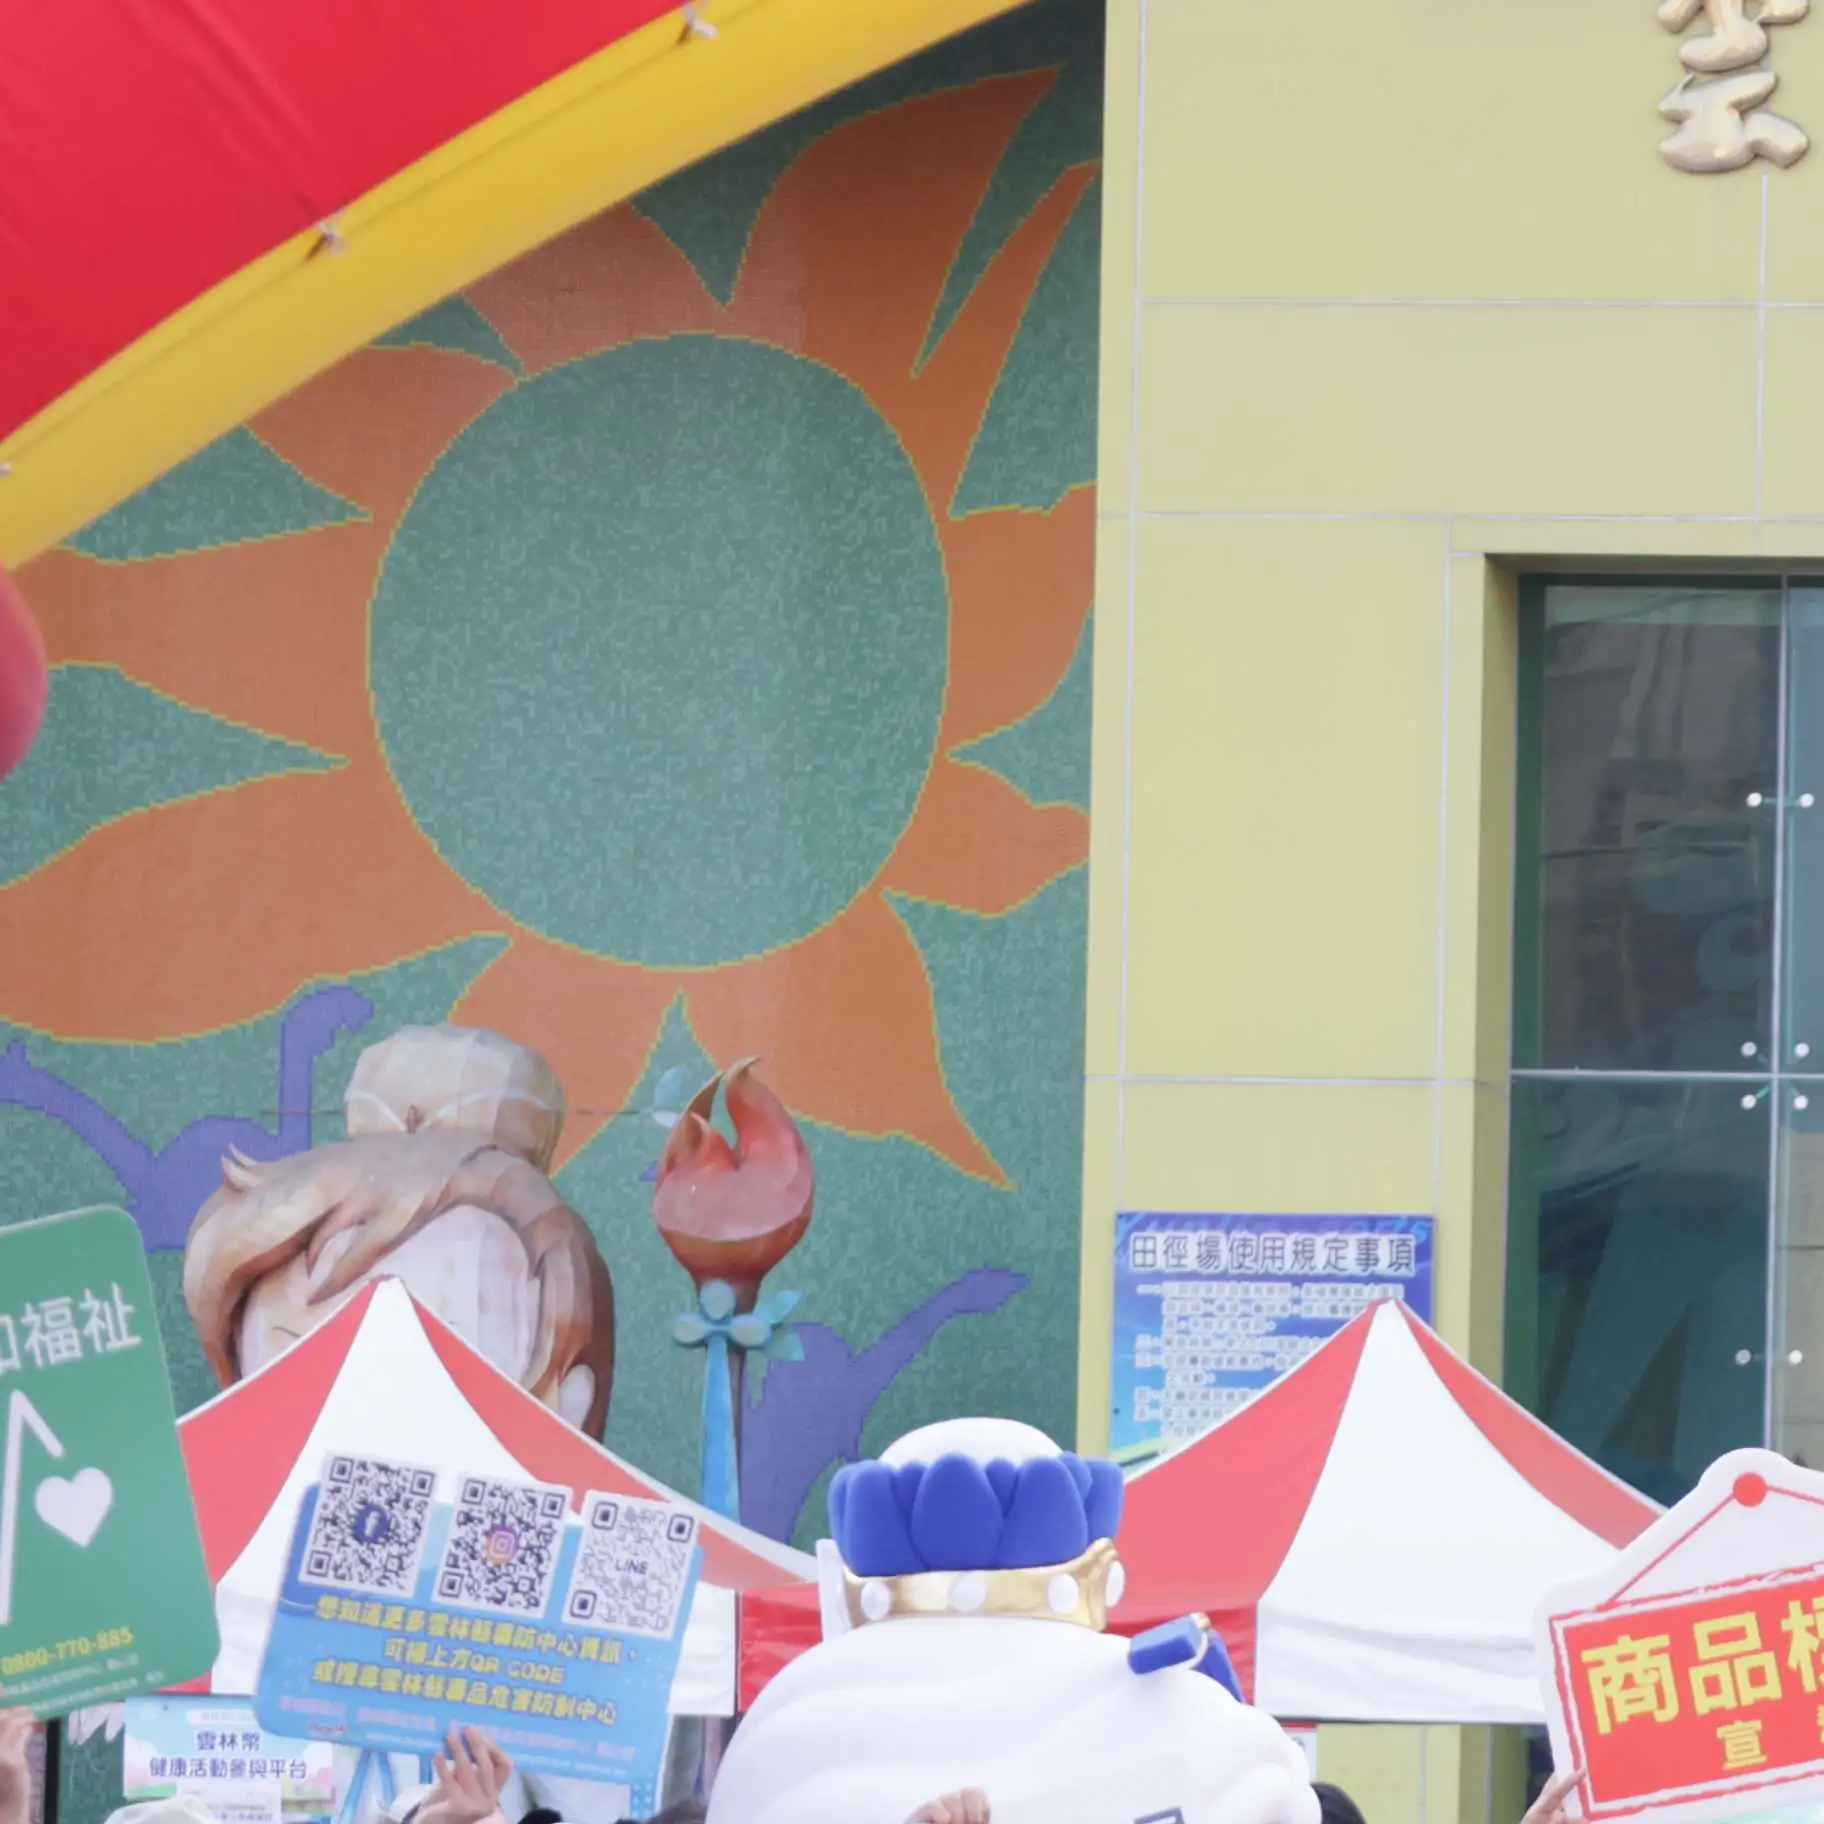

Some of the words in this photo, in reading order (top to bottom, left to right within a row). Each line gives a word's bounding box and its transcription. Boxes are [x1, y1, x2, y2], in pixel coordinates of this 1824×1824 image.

[1130, 1231, 1416, 1276] 田徑場使用規定事項
[1717, 1719, 1768, 1770] 宣
[149, 1758, 308, 1780] 健康活動參與平台
